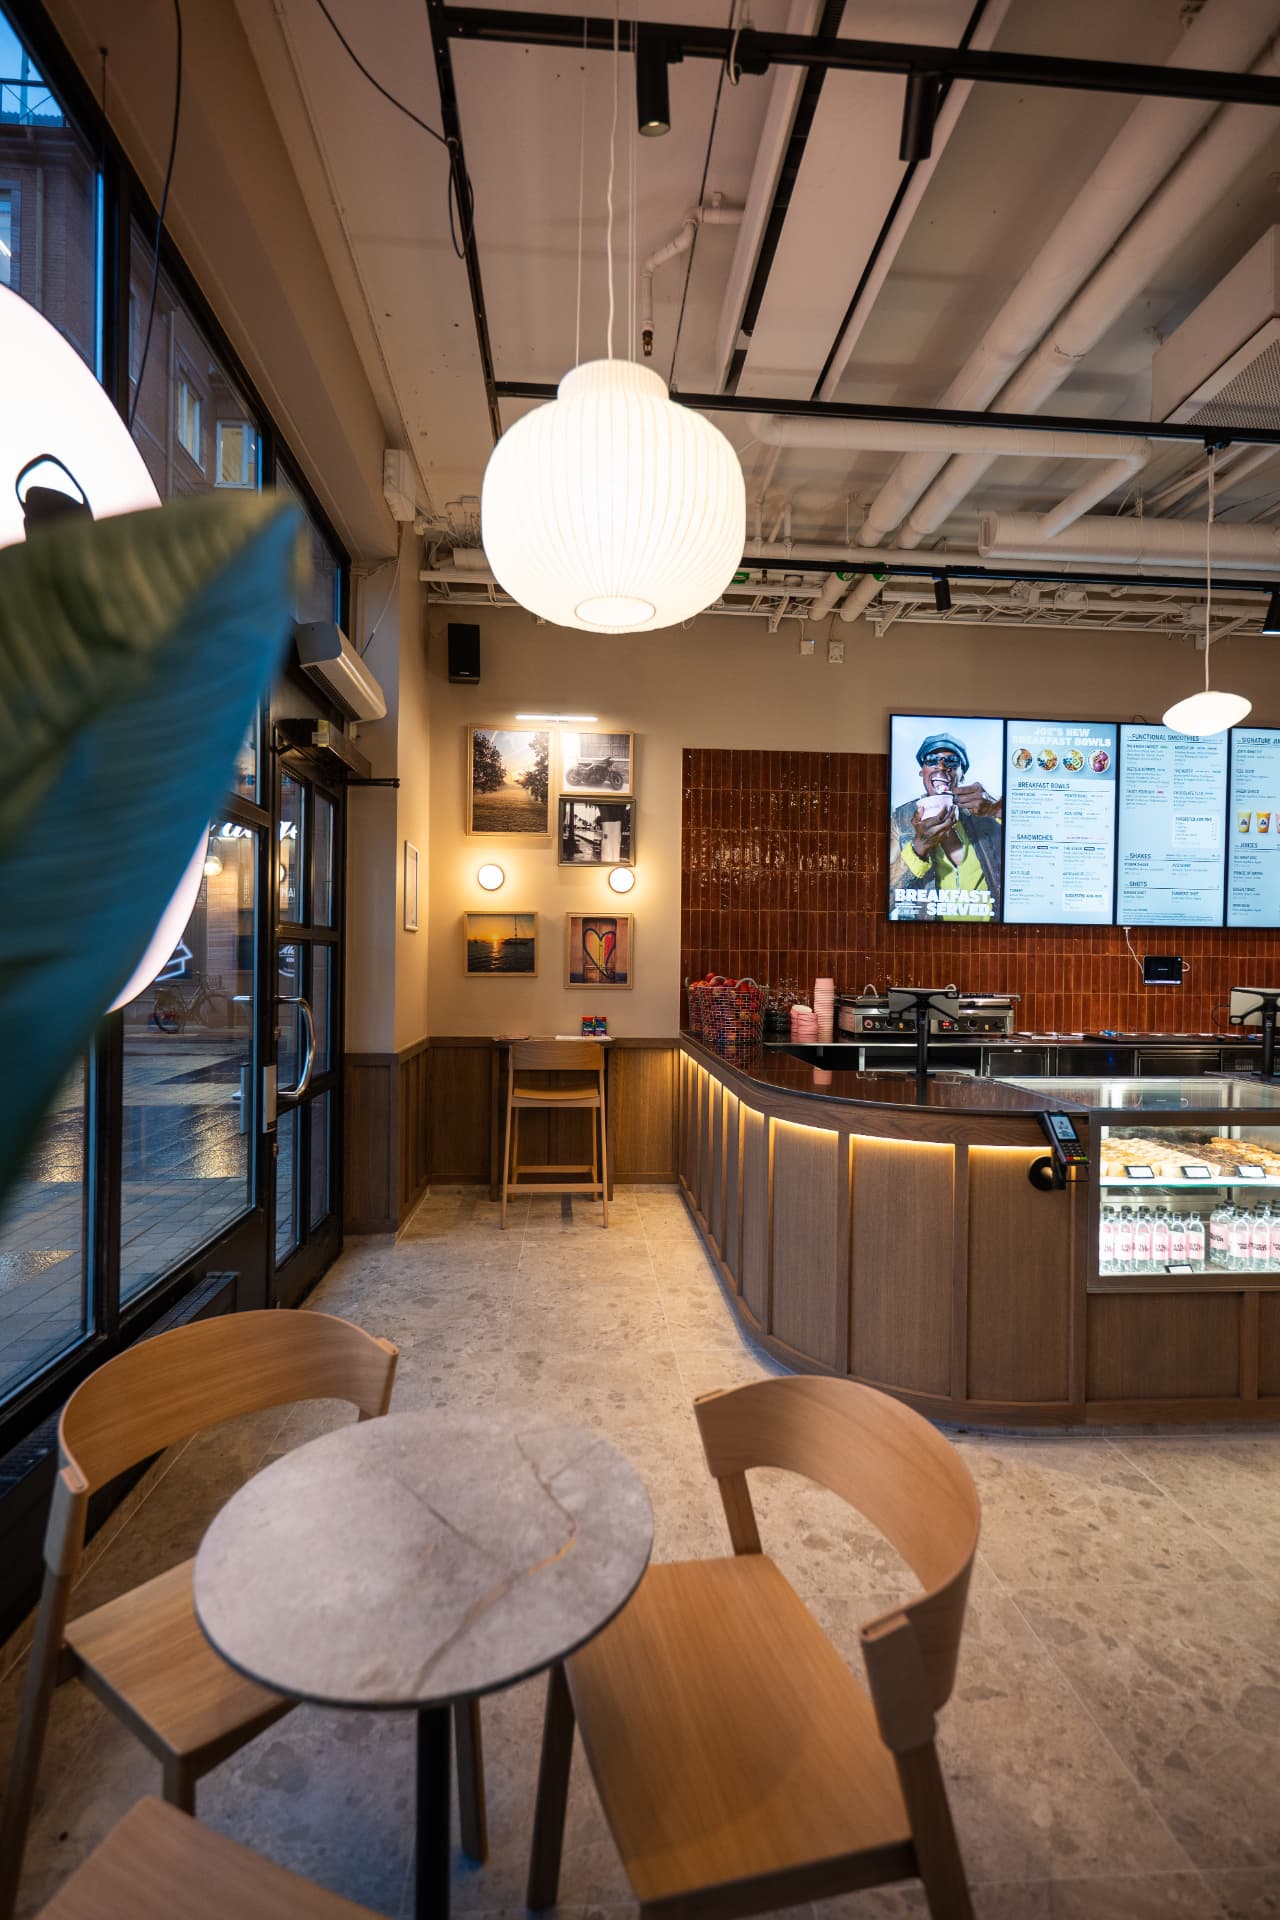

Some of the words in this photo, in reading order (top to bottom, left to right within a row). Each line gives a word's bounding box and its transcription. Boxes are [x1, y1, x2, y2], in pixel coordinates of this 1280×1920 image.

[1066, 728, 1090, 737] NEW
[1013, 735, 1073, 746] BREAKFAST
[1074, 737, 1112, 747] BOWLS
[1131, 733, 1167, 741] FUNCTIONAL
[1167, 734, 1200, 742] SMOOTHIES
[1017, 781, 1050, 789] BREAKFAST
[1016, 833, 1053, 841] SANDWICHES
[894, 888, 996, 904] BREAKFAST.
[926, 902, 996, 917] SERVED.
